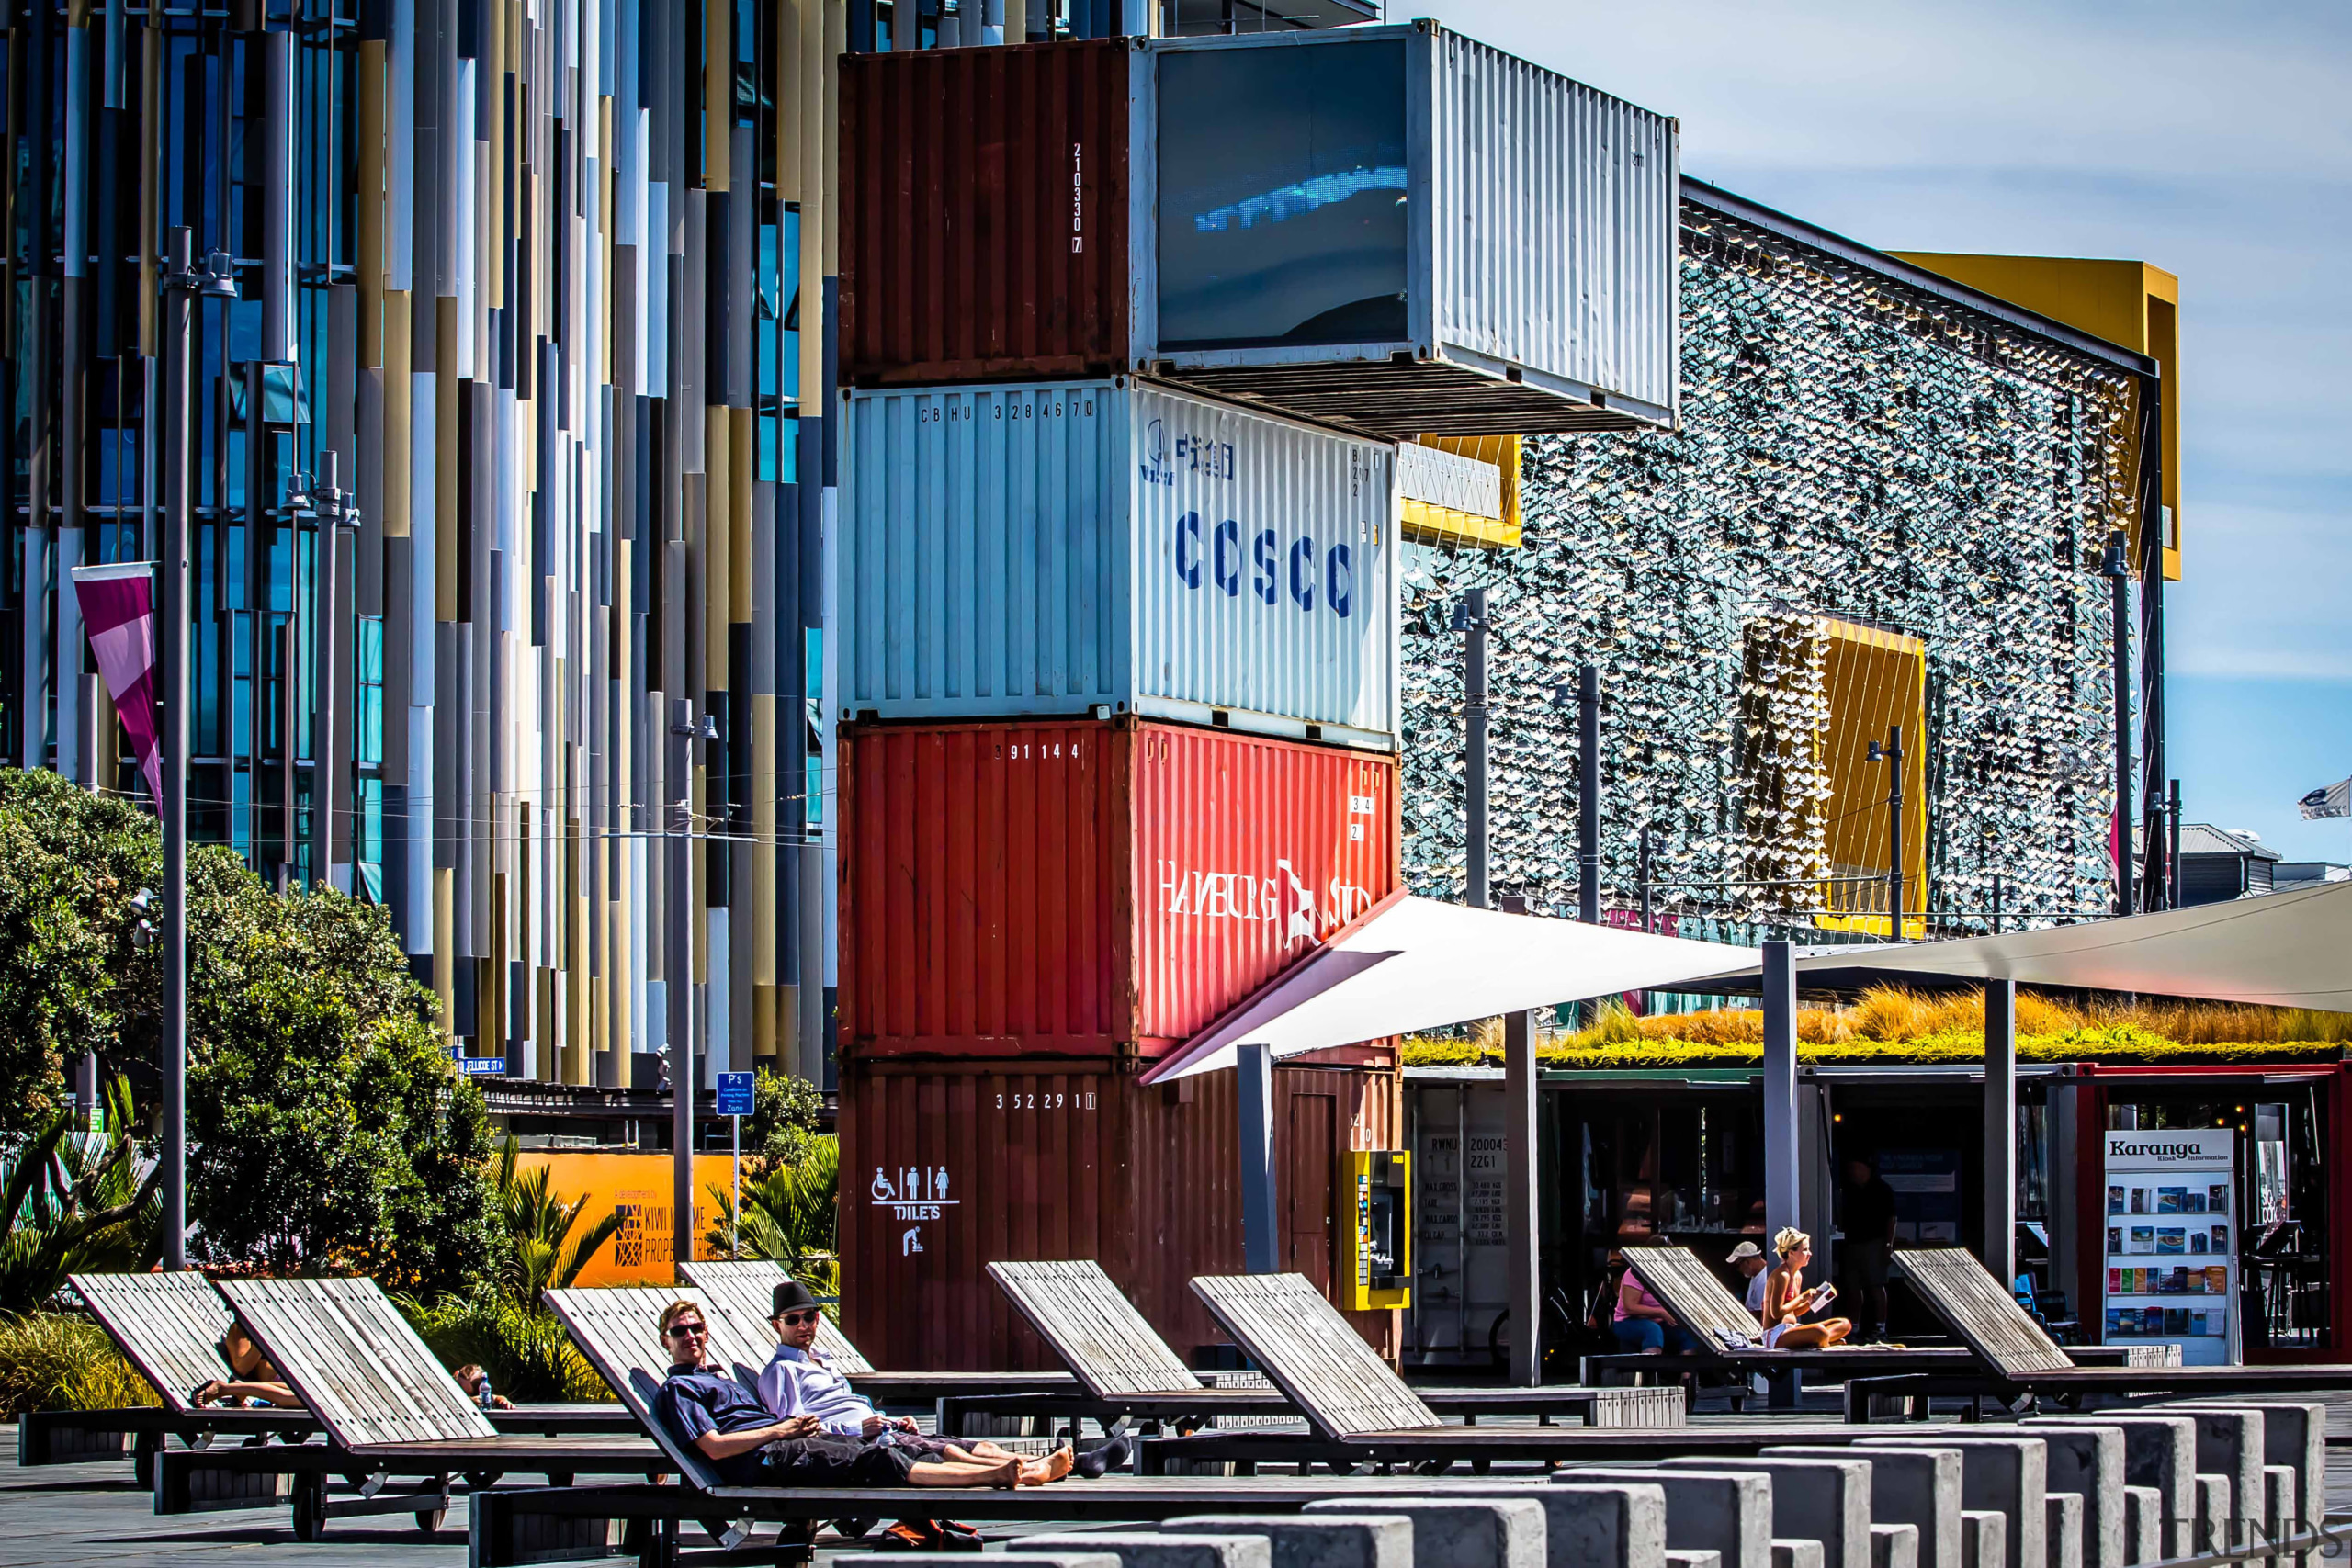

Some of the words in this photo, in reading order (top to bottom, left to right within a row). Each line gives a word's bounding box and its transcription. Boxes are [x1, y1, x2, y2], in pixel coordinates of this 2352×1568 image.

[921, 405, 971, 423] CBHU
[1175, 511, 1352, 618] COSCO
[1432, 1138, 1458, 1152] RWNU
[2109, 1140, 2201, 1159] Karanga
[644, 1206, 667, 1231] KIWI
